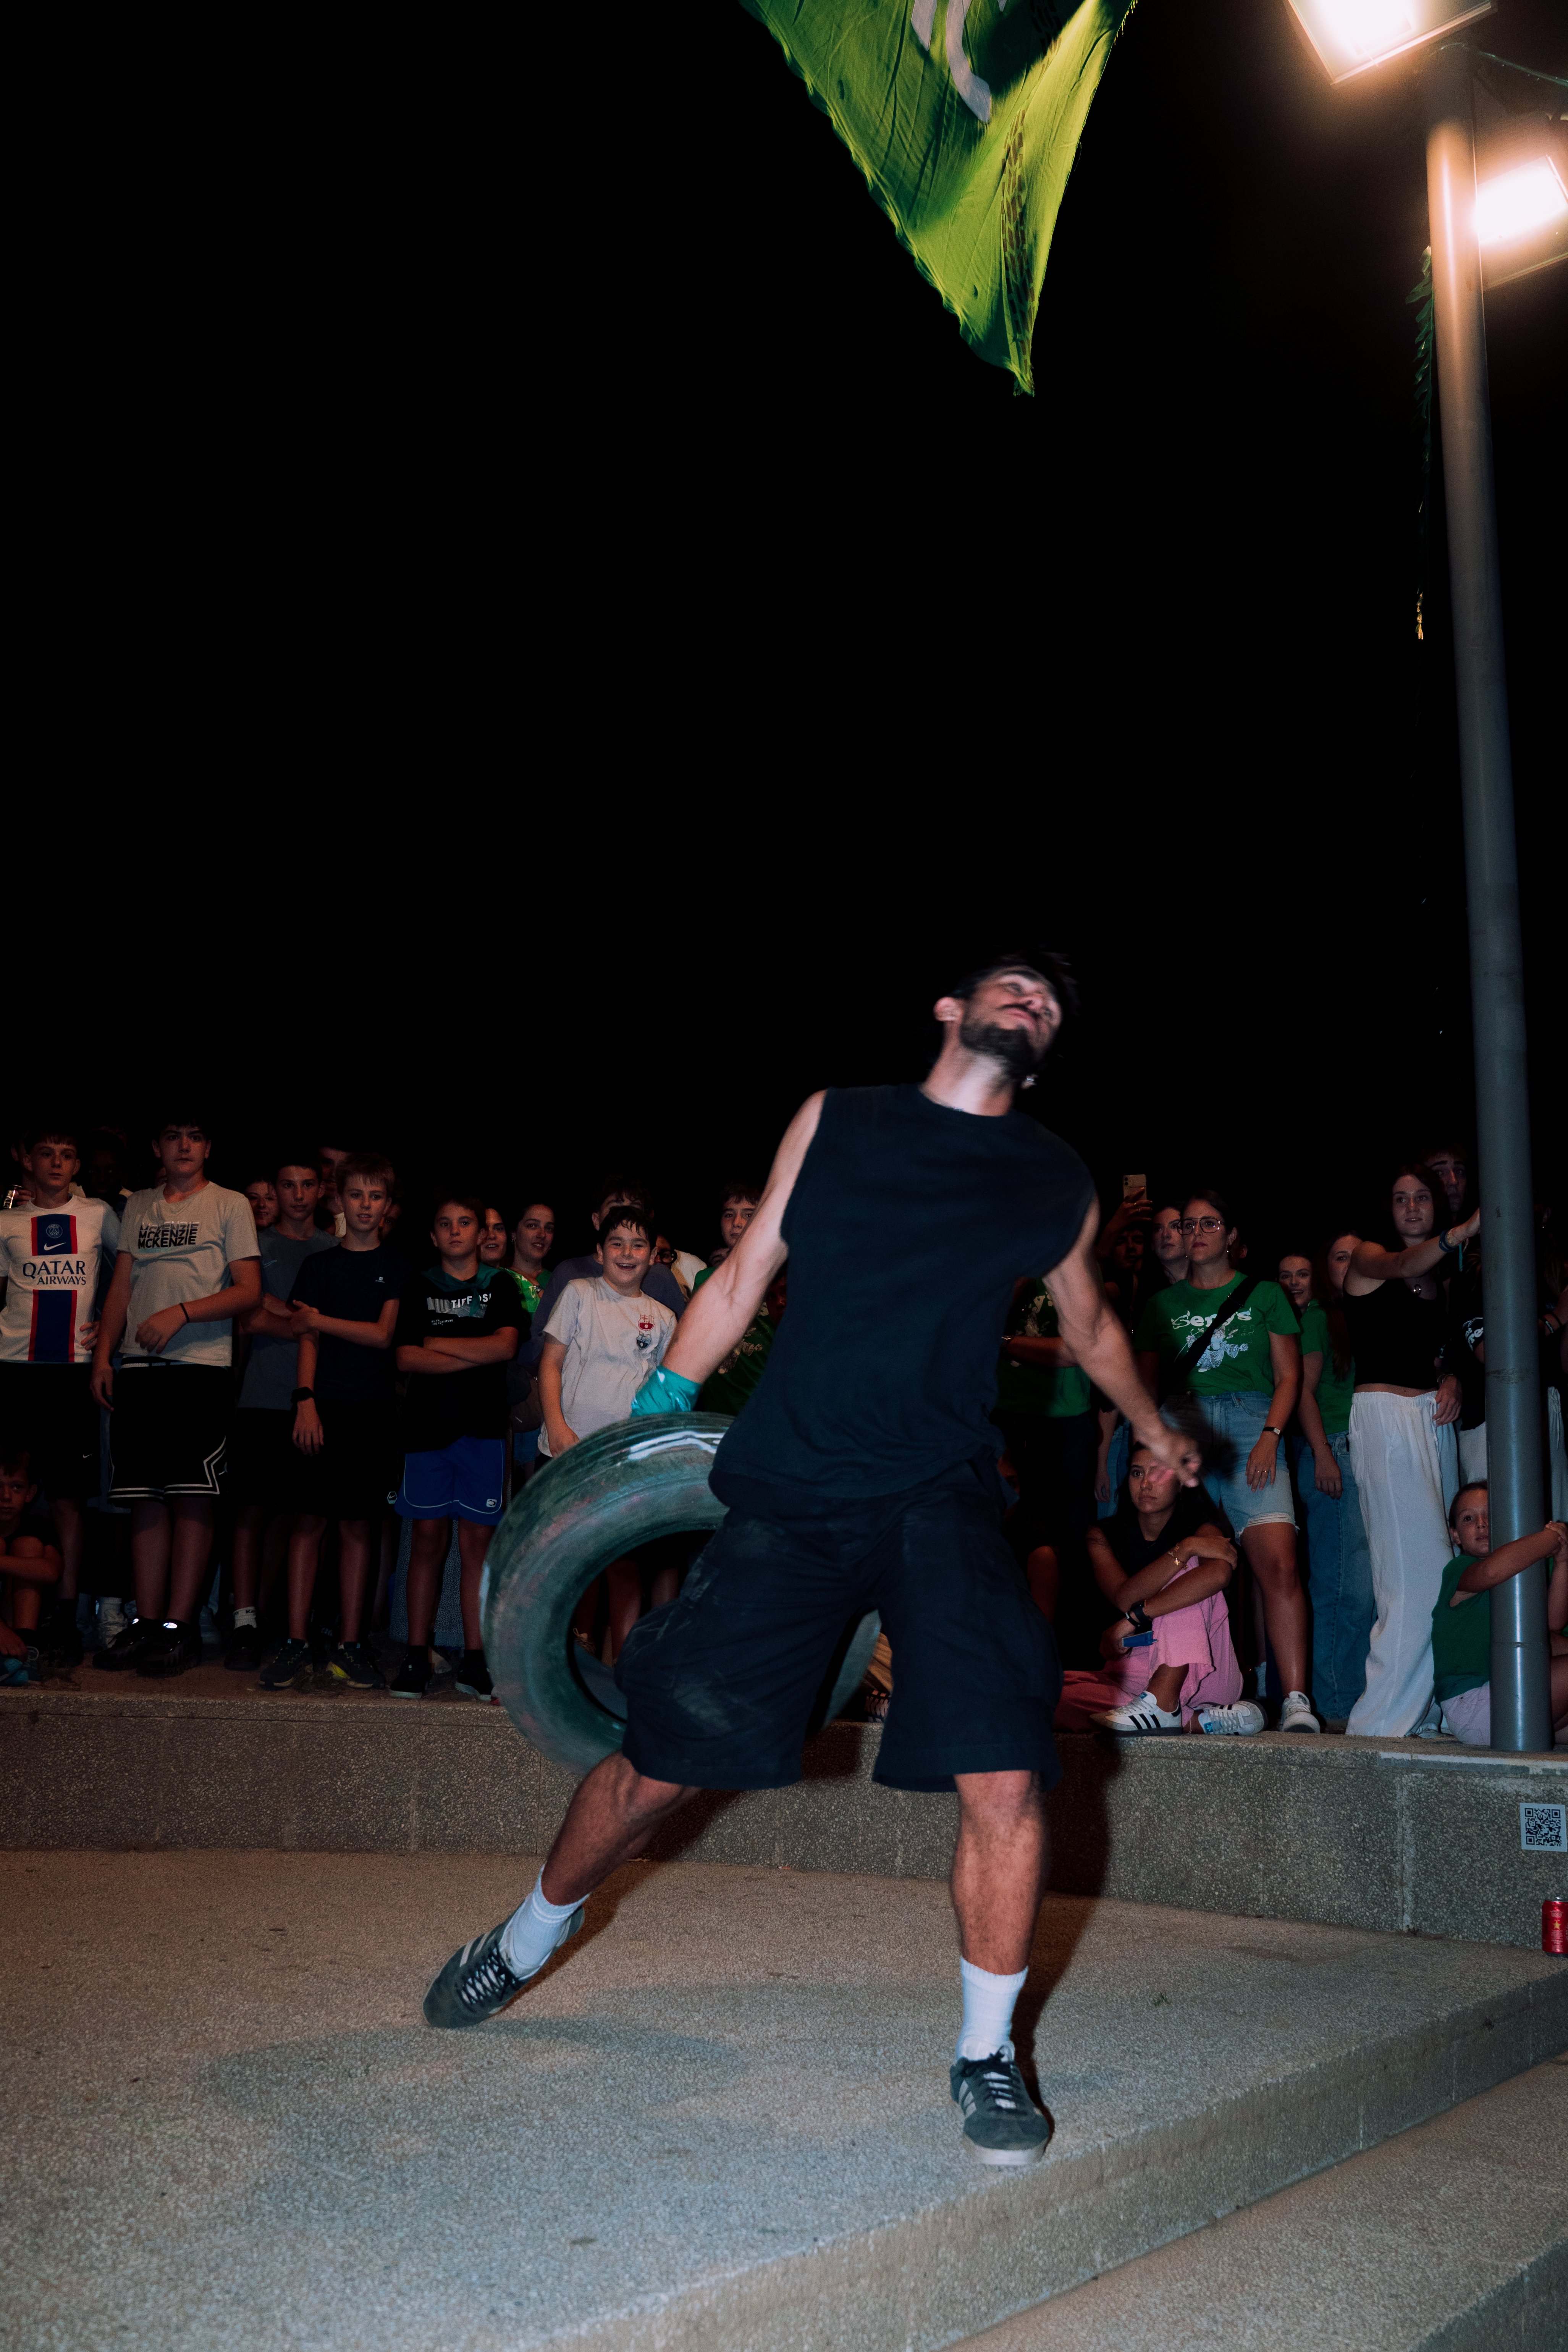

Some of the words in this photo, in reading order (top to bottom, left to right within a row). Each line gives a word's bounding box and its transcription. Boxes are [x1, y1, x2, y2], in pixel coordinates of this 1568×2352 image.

[138, 1236, 197, 1249] MCKENZIE
[23, 1260, 86, 1279] QATAR
[37, 1276, 86, 1285] AIRWAYS
[451, 1293, 491, 1308] TIFFSI
